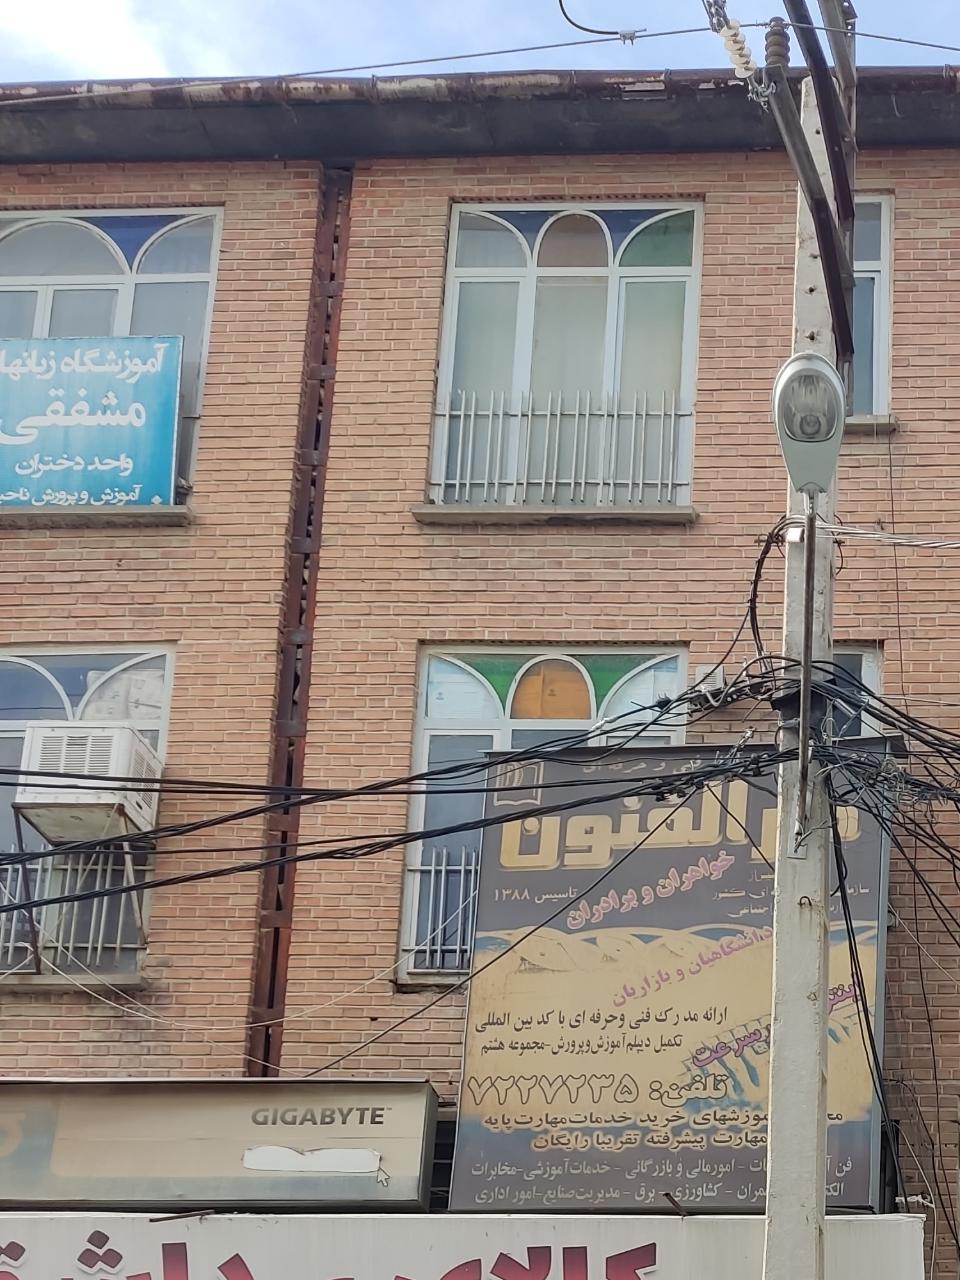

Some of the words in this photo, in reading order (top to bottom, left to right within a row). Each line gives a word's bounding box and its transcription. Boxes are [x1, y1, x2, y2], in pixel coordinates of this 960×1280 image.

[61, 343, 170, 383] آموزشگاه
[0, 387, 146, 445] مشفقی
[15, 453, 84, 478] دختران
[87, 452, 134, 477] واحد
[32, 488, 78, 506] پرورش
[78, 490, 89, 505] و
[90, 484, 143, 506] آموزش
[656, 850, 735, 898] خواهران
[495, 888, 530, 902] ۱۳۸۸
[535, 886, 578, 903] تاسیس
[641, 886, 655, 905] و
[566, 889, 639, 929] برادران
[676, 968, 686, 982] و
[613, 968, 671, 1008] بازاریان
[475, 1012, 510, 1032] المللی
[513, 1016, 533, 1032] بین
[536, 1010, 555, 1026] کد
[558, 1011, 565, 1029] با
[569, 1010, 586, 1029] ای
[628, 1008, 651, 1029] فنی
[702, 1006, 728, 1025] ارائه
[653, 1033, 683, 1053] تکمیل
[484, 1113, 512, 1130] پایه
[514, 1112, 568, 1128] مهارت
[568, 1111, 632, 1126] خدمات
[639, 1111, 685, 1128] خرید
[533, 1133, 589, 1151] رایگان
[594, 1133, 640, 1151] تقریبا
[646, 1131, 705, 1150] پیشرفته
[713, 1131, 768, 1147] مهارت
[625, 1158, 673, 1180] بازرگانی
[634, 1183, 655, 1203] برق
[671, 1182, 723, 1202] کشاورزی
